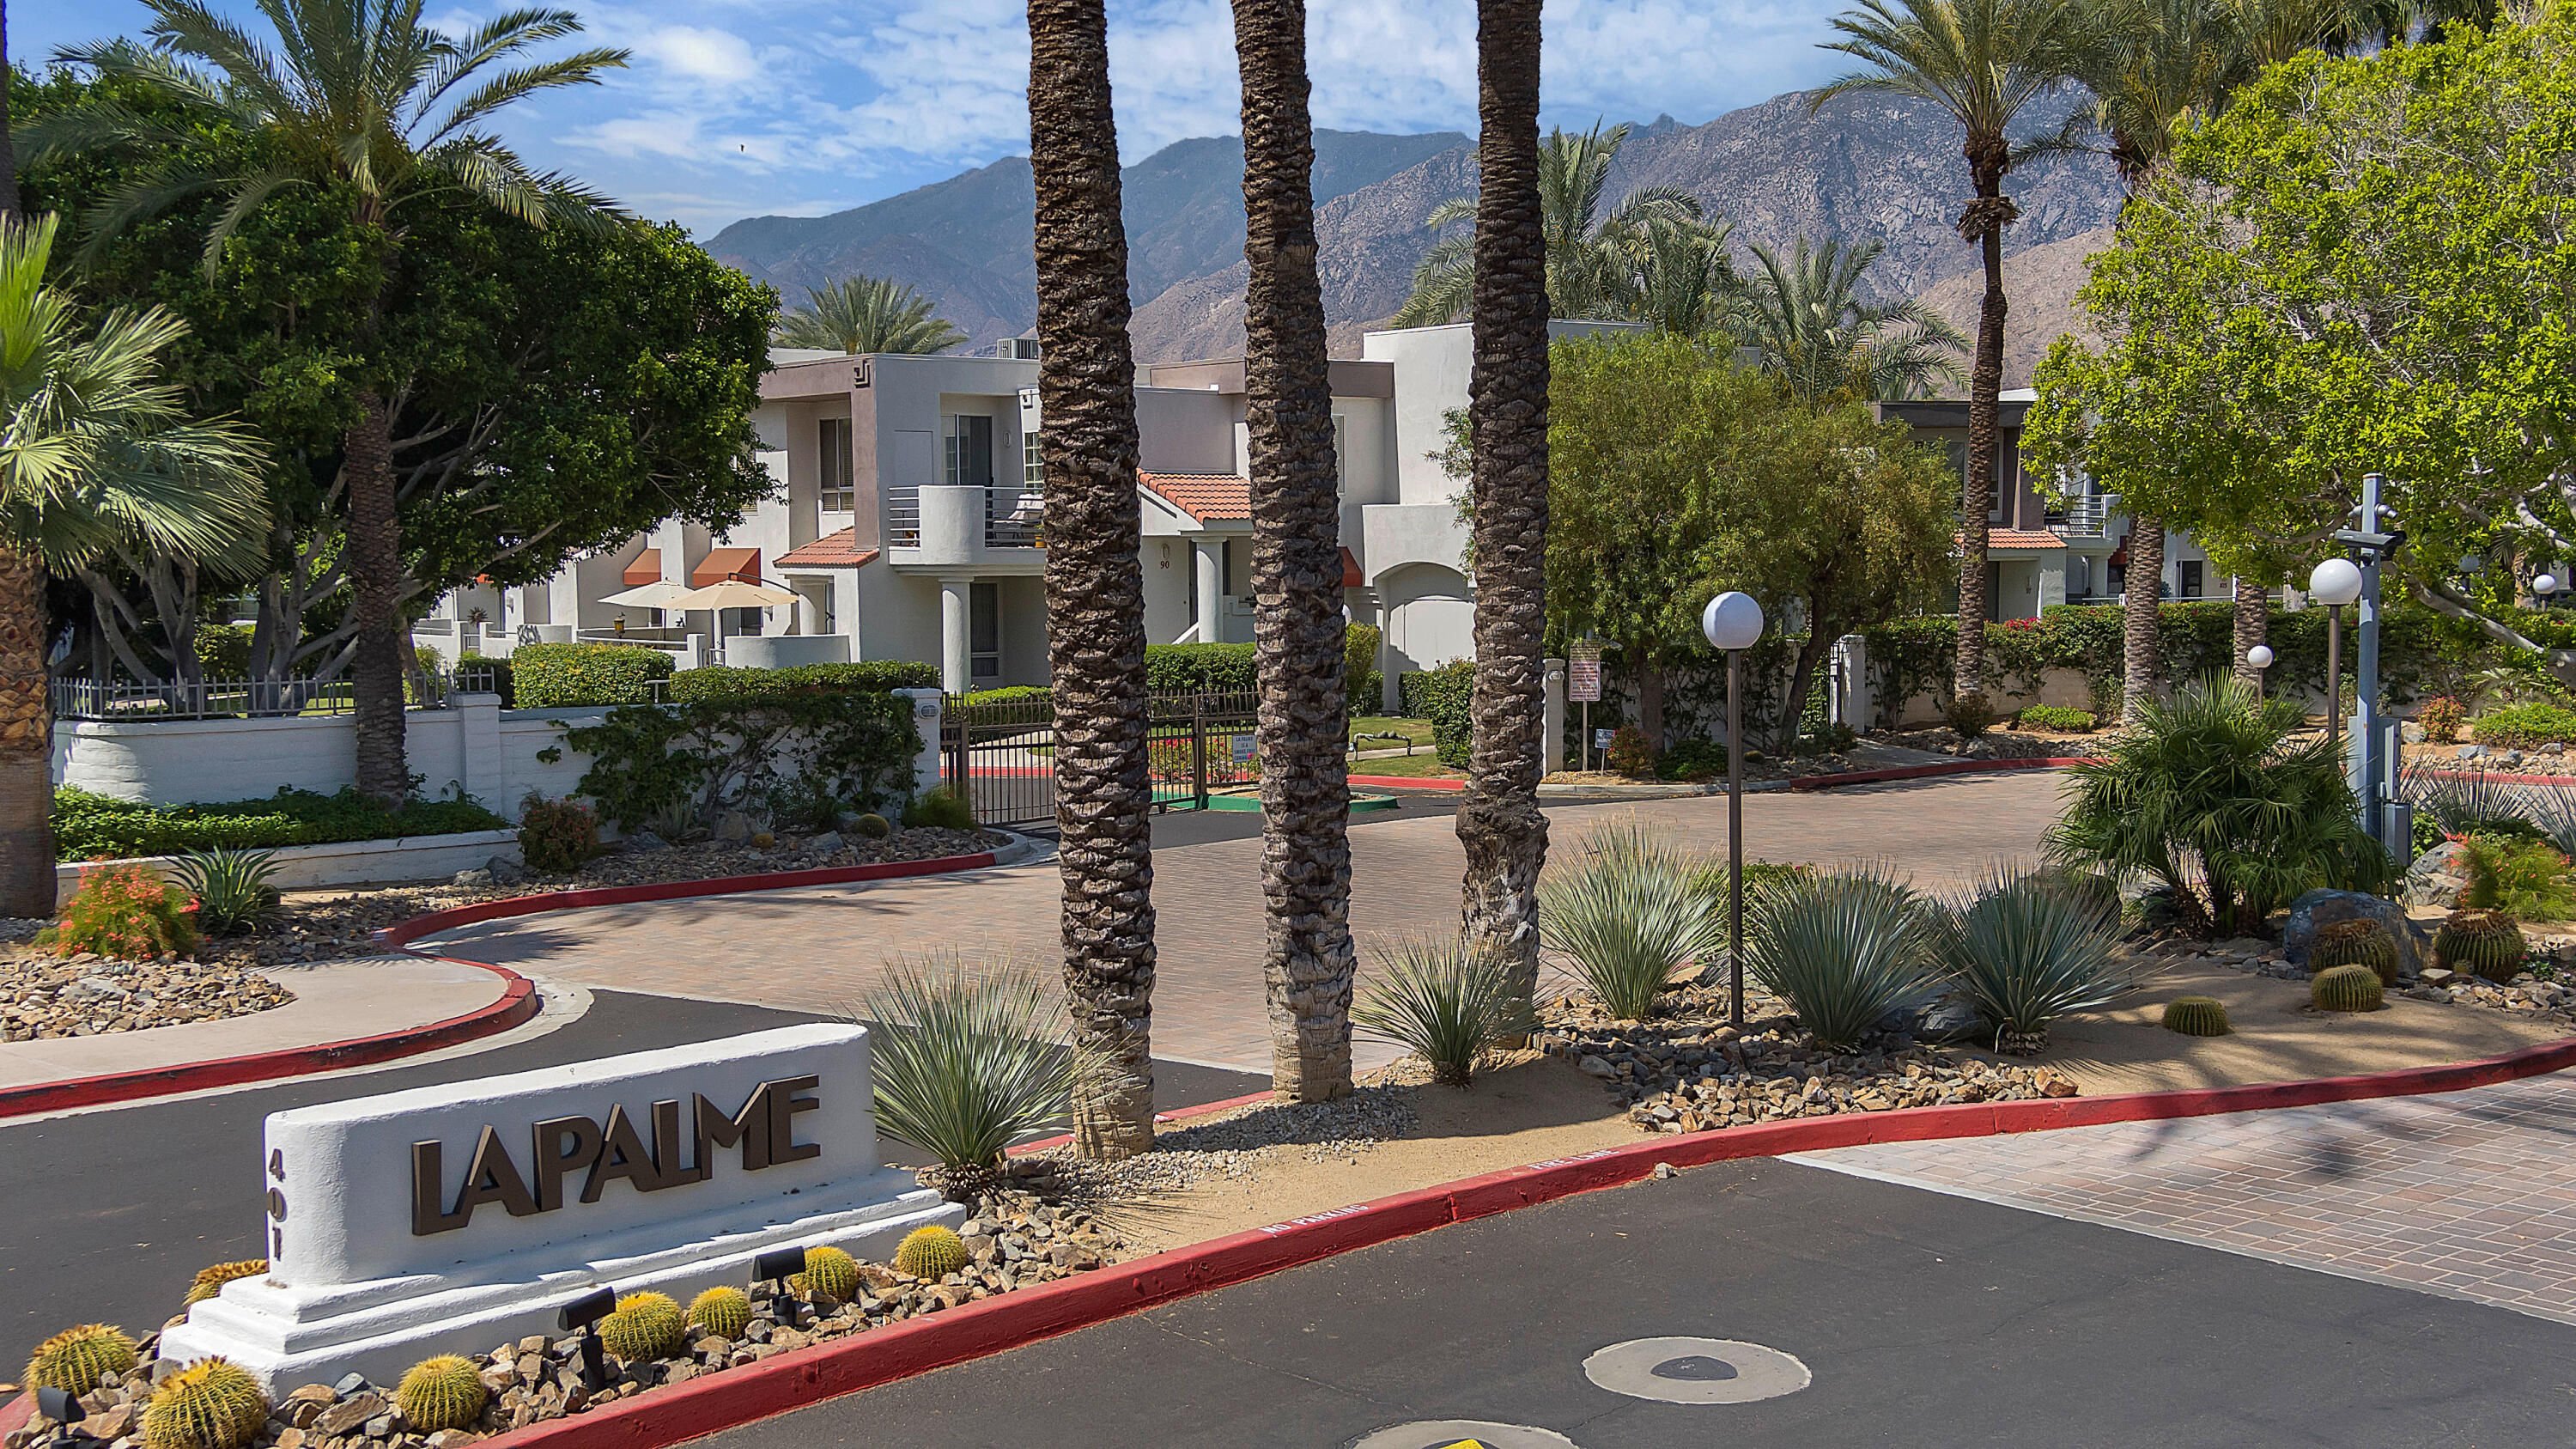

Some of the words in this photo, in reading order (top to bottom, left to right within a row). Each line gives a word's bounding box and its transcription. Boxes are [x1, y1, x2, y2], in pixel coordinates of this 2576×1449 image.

[1161, 560, 1170, 569] 90
[1526, 1159, 1573, 1170] FIRE
[1568, 1148, 1620, 1161] LANE
[1258, 1223, 1292, 1233] NO
[1291, 1204, 1369, 1226] PARKING
